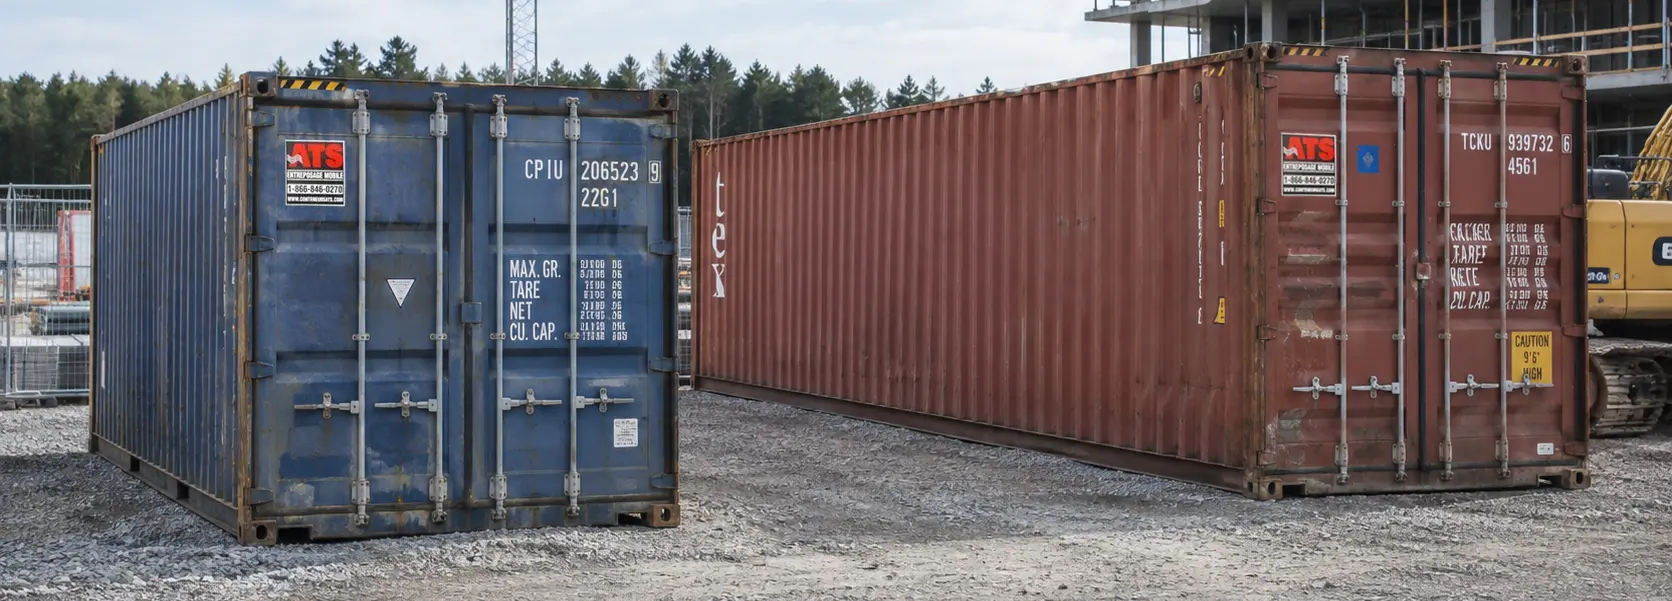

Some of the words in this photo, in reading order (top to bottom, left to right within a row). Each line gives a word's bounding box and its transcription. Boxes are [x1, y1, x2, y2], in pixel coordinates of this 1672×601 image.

[1284, 136, 1335, 161] ATS
[1461, 132, 1492, 151] TCKU
[1508, 133, 1554, 152] 939732
[1562, 135, 1571, 153] 6
[287, 142, 343, 169] ATS
[524, 159, 563, 180] CPIU
[581, 160, 639, 181] 206523
[650, 162, 660, 182] 9
[288, 184, 343, 193] 1-866-846-0270
[581, 187, 617, 207] 22G1
[510, 259, 540, 278] MAX.
[542, 259, 561, 278] GR.
[510, 280, 541, 299] TARE
[510, 301, 532, 320] NET
[510, 322, 528, 341] CU.
[532, 322, 558, 341] CAP.
[1515, 334, 1549, 347] CAUTION
